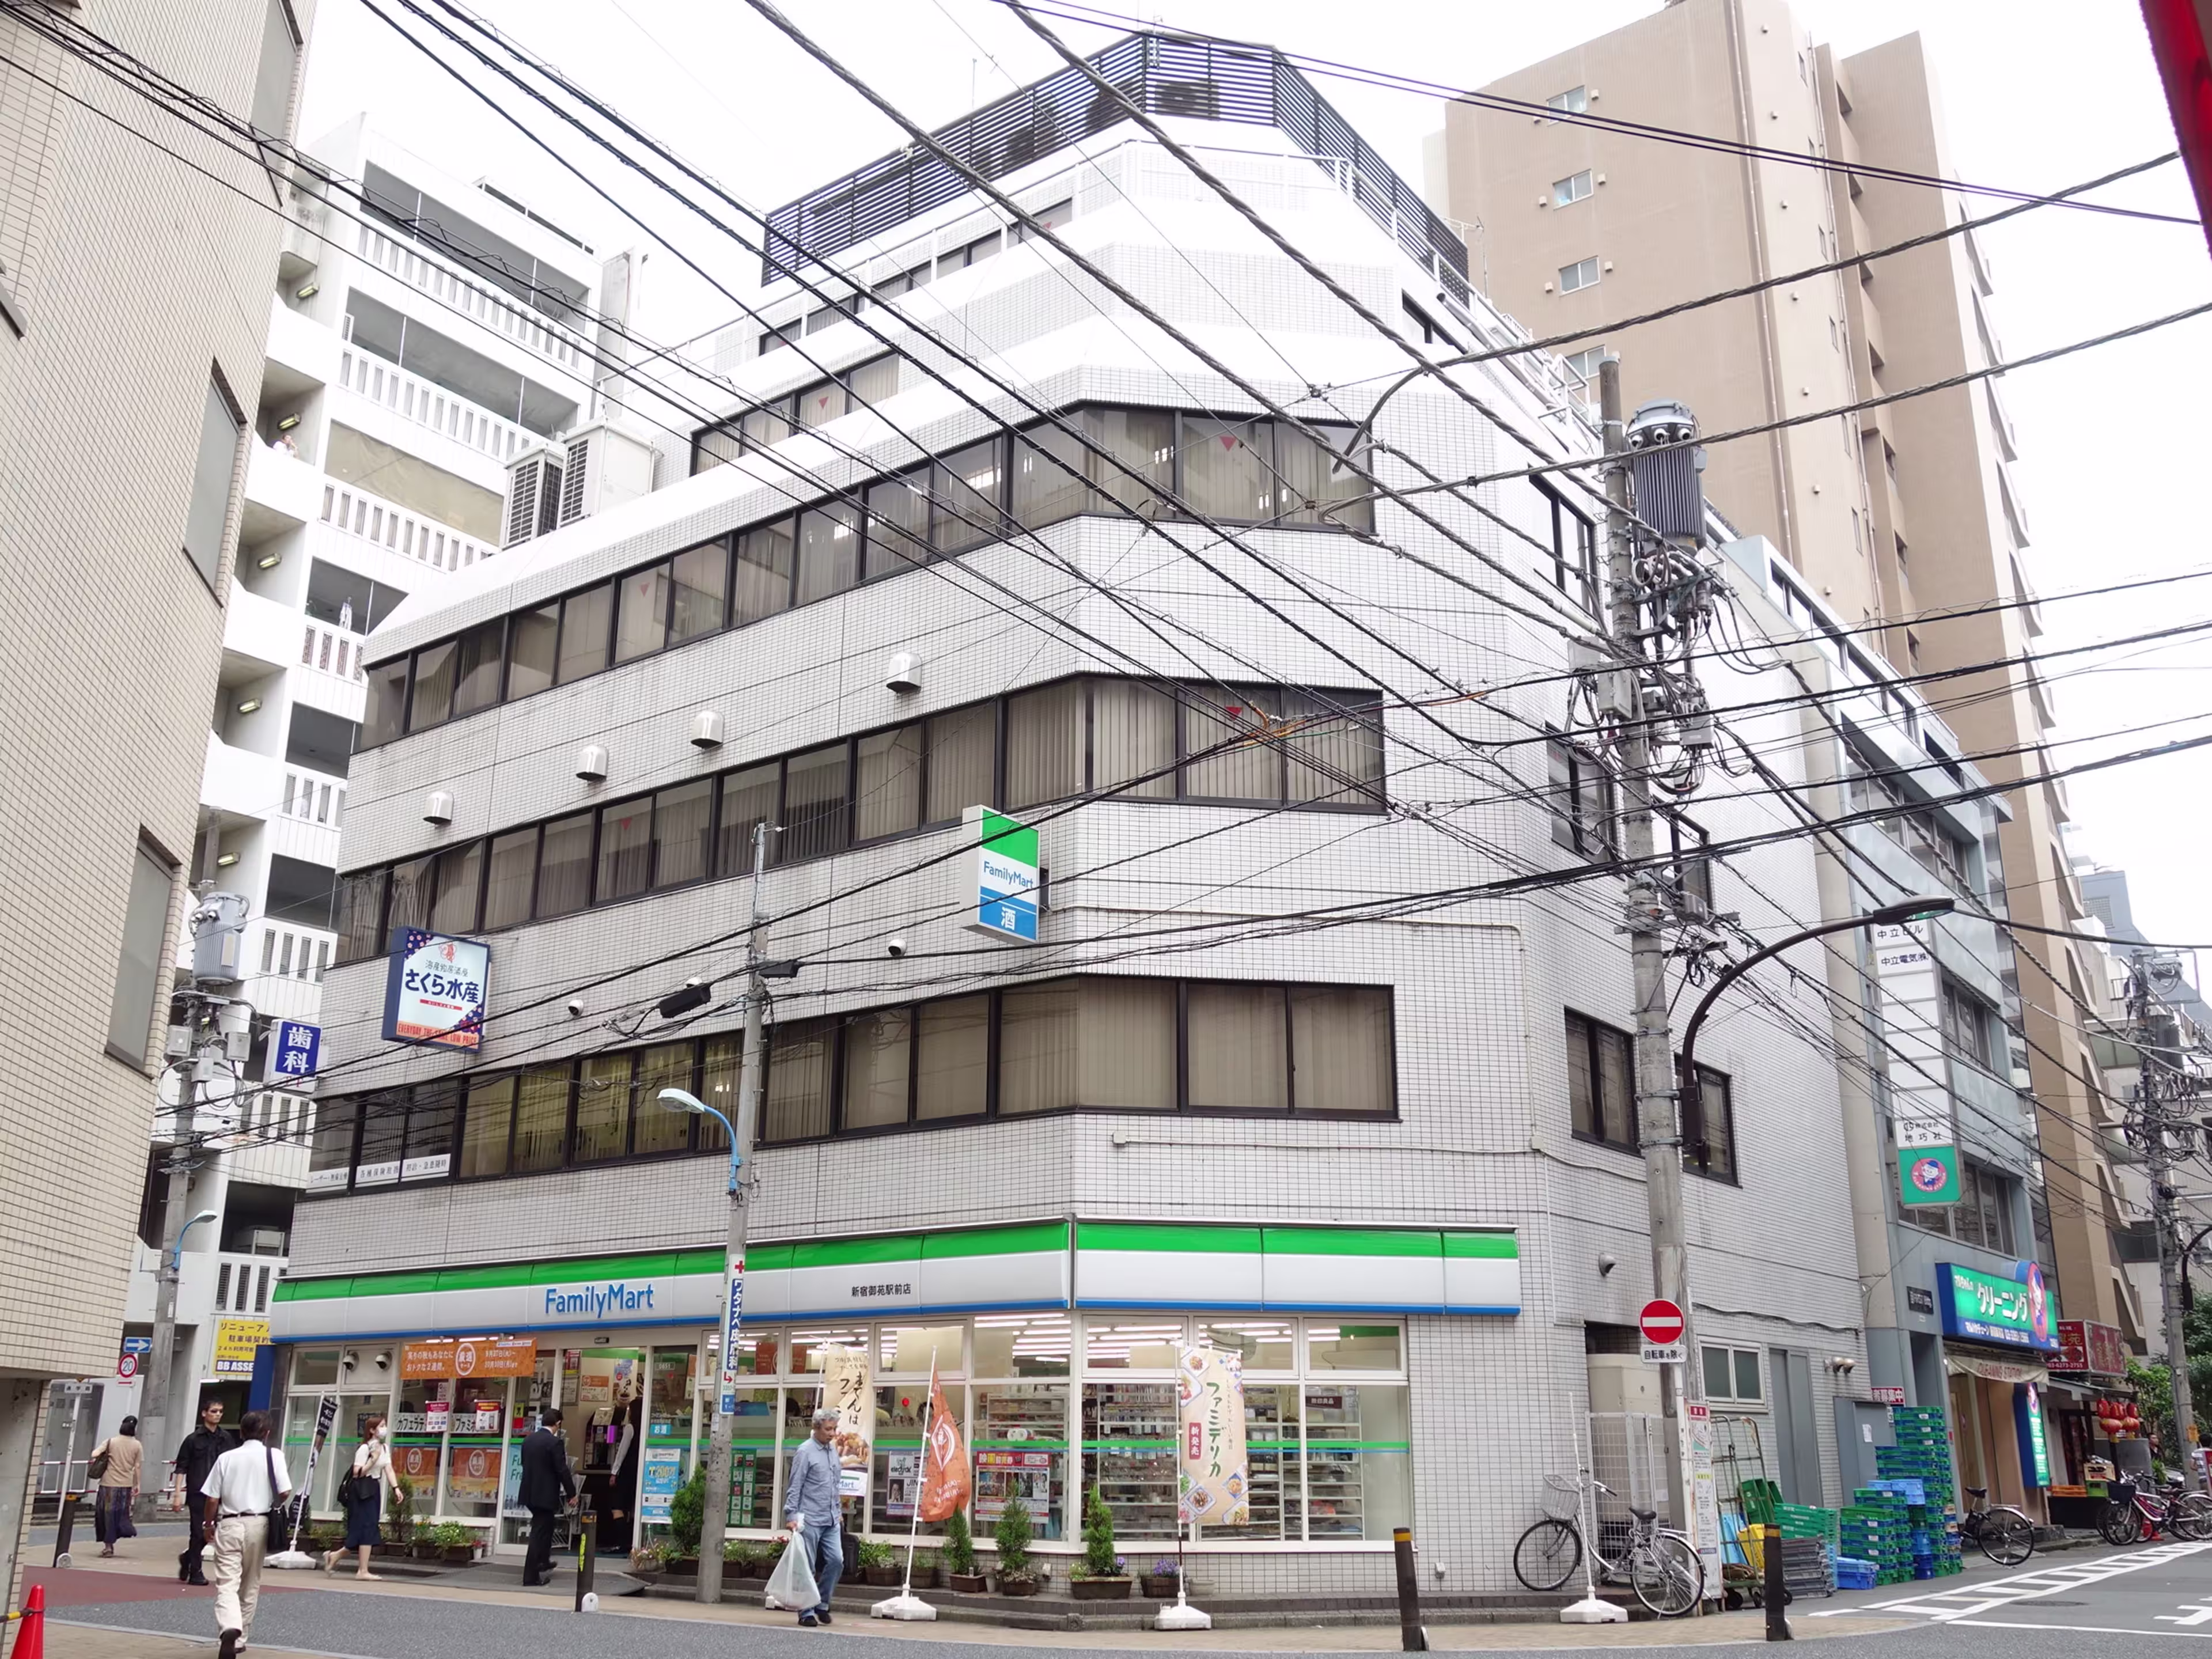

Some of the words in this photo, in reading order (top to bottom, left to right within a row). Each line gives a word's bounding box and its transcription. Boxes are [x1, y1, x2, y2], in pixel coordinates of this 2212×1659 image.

[983, 860, 1034, 888] FamilyMart
[1001, 906, 1016, 931] 酒
[405, 968, 479, 1003] さくら水産
[398, 1022, 421, 1035] EVERYDAY
[283, 1026, 313, 1074] 歯科
[545, 1282, 654, 1319] FamilyMart
[851, 1283, 911, 1297] 新宿御苑駅前店
[1977, 1282, 2029, 1322] クリーニング
[123, 1361, 133, 1372] 20
[1644, 1349, 1683, 1359] 自転車を除く
[1190, 1426, 1200, 1456] 新発売
[1206, 1381, 1227, 1478] ファミデリカ
